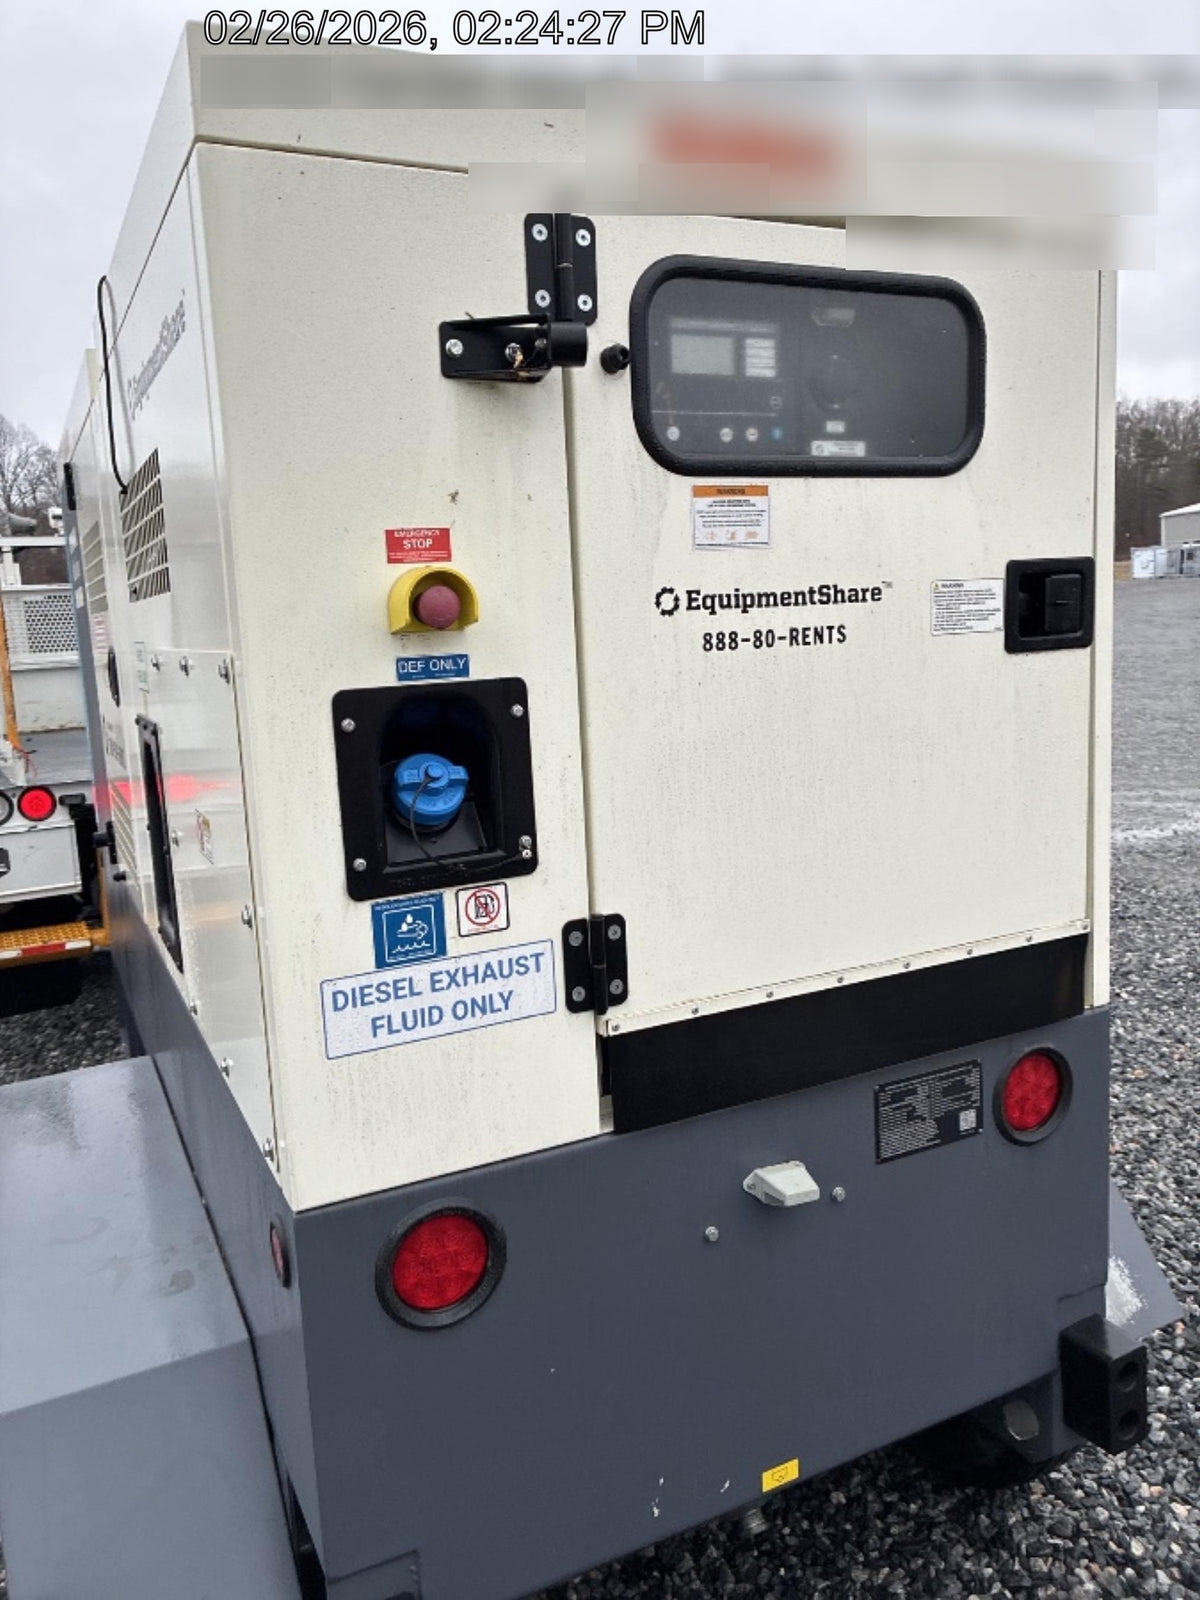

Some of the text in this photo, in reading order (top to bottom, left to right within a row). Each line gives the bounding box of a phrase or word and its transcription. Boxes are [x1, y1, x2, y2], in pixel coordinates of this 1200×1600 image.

[402, 537, 433, 550] STOP
[685, 583, 883, 616] EquipmentShare
[702, 623, 848, 652] 888-80-RENTS
[397, 656, 468, 674] DEF ONLY
[331, 951, 545, 1013] DIESEL EXHAUST
[370, 989, 514, 1039] FLUID ONLY
